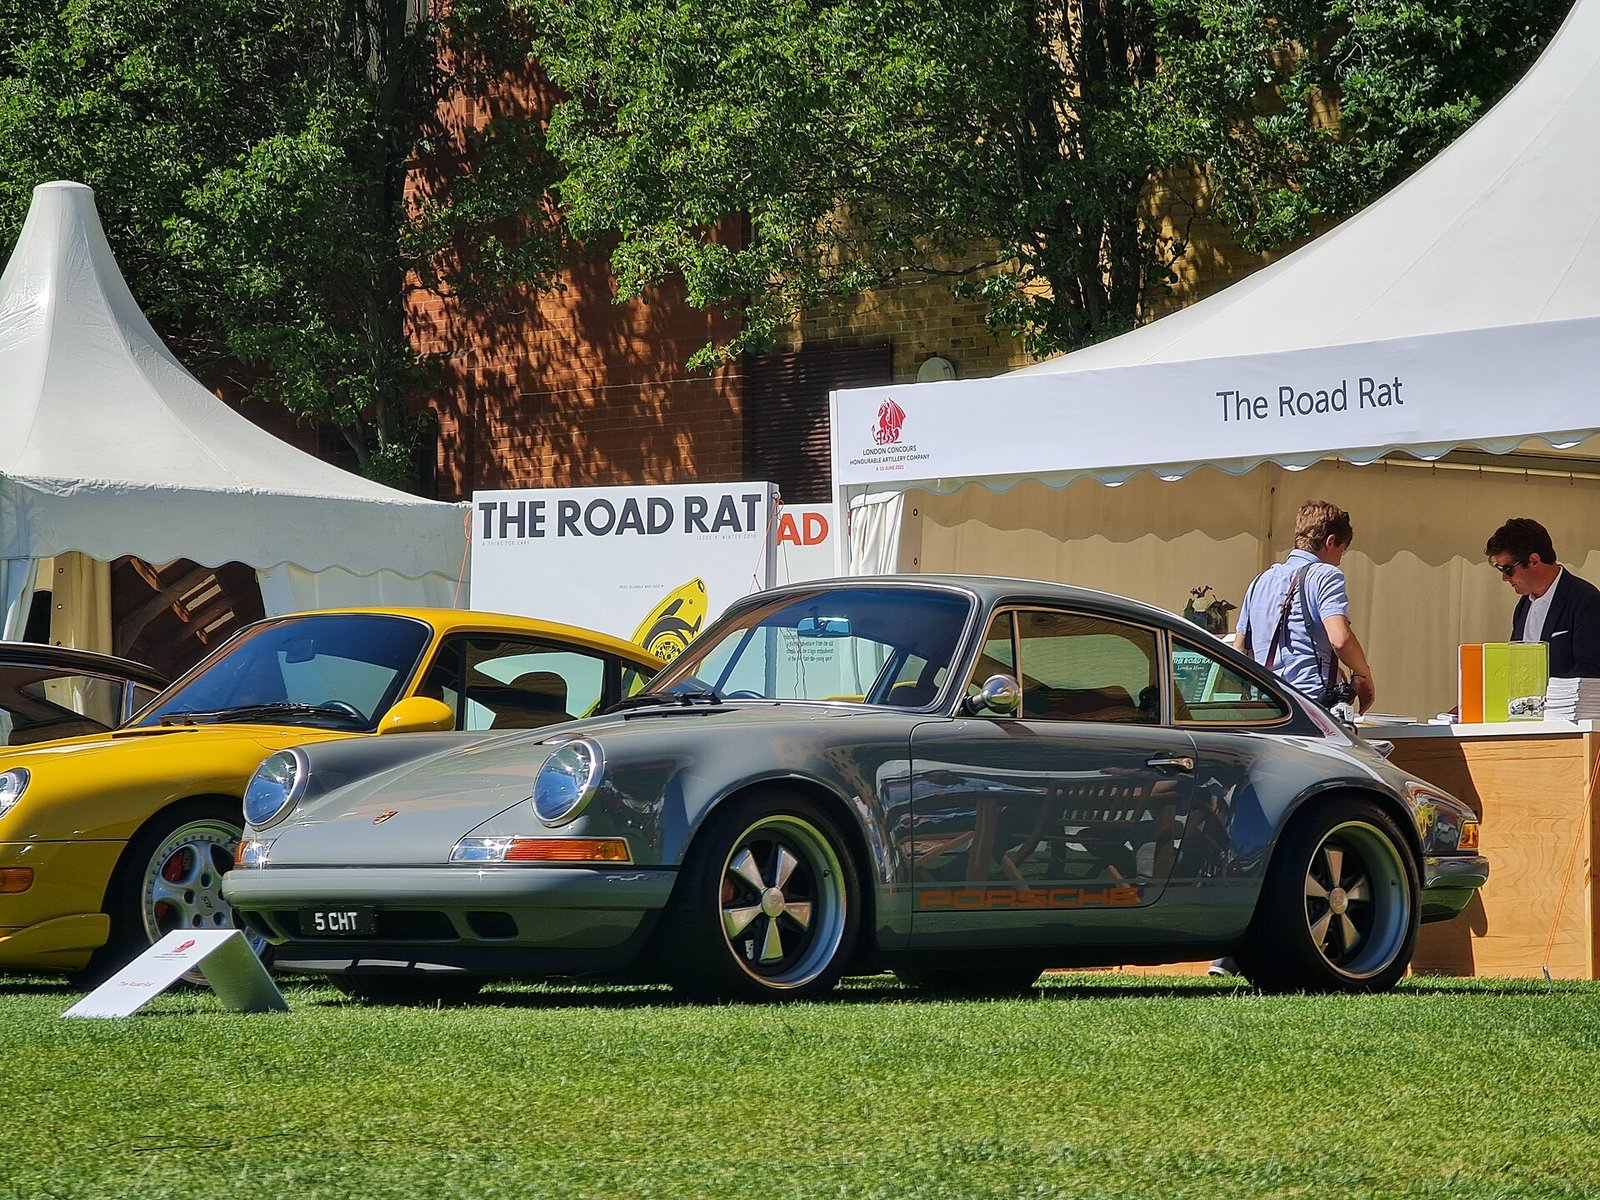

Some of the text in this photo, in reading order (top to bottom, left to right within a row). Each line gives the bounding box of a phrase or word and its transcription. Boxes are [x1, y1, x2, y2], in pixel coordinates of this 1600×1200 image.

[1216, 376, 1404, 422] The Road Rat
[850, 457, 882, 465] HONOURABLE
[882, 455, 906, 463] ARTILLERY
[862, 445, 917, 456] LONDON CONCOURS
[479, 493, 762, 539] THE ROAD RAT
[920, 887, 1139, 911] PORSCHE
[314, 911, 358, 930] 5 CHT
